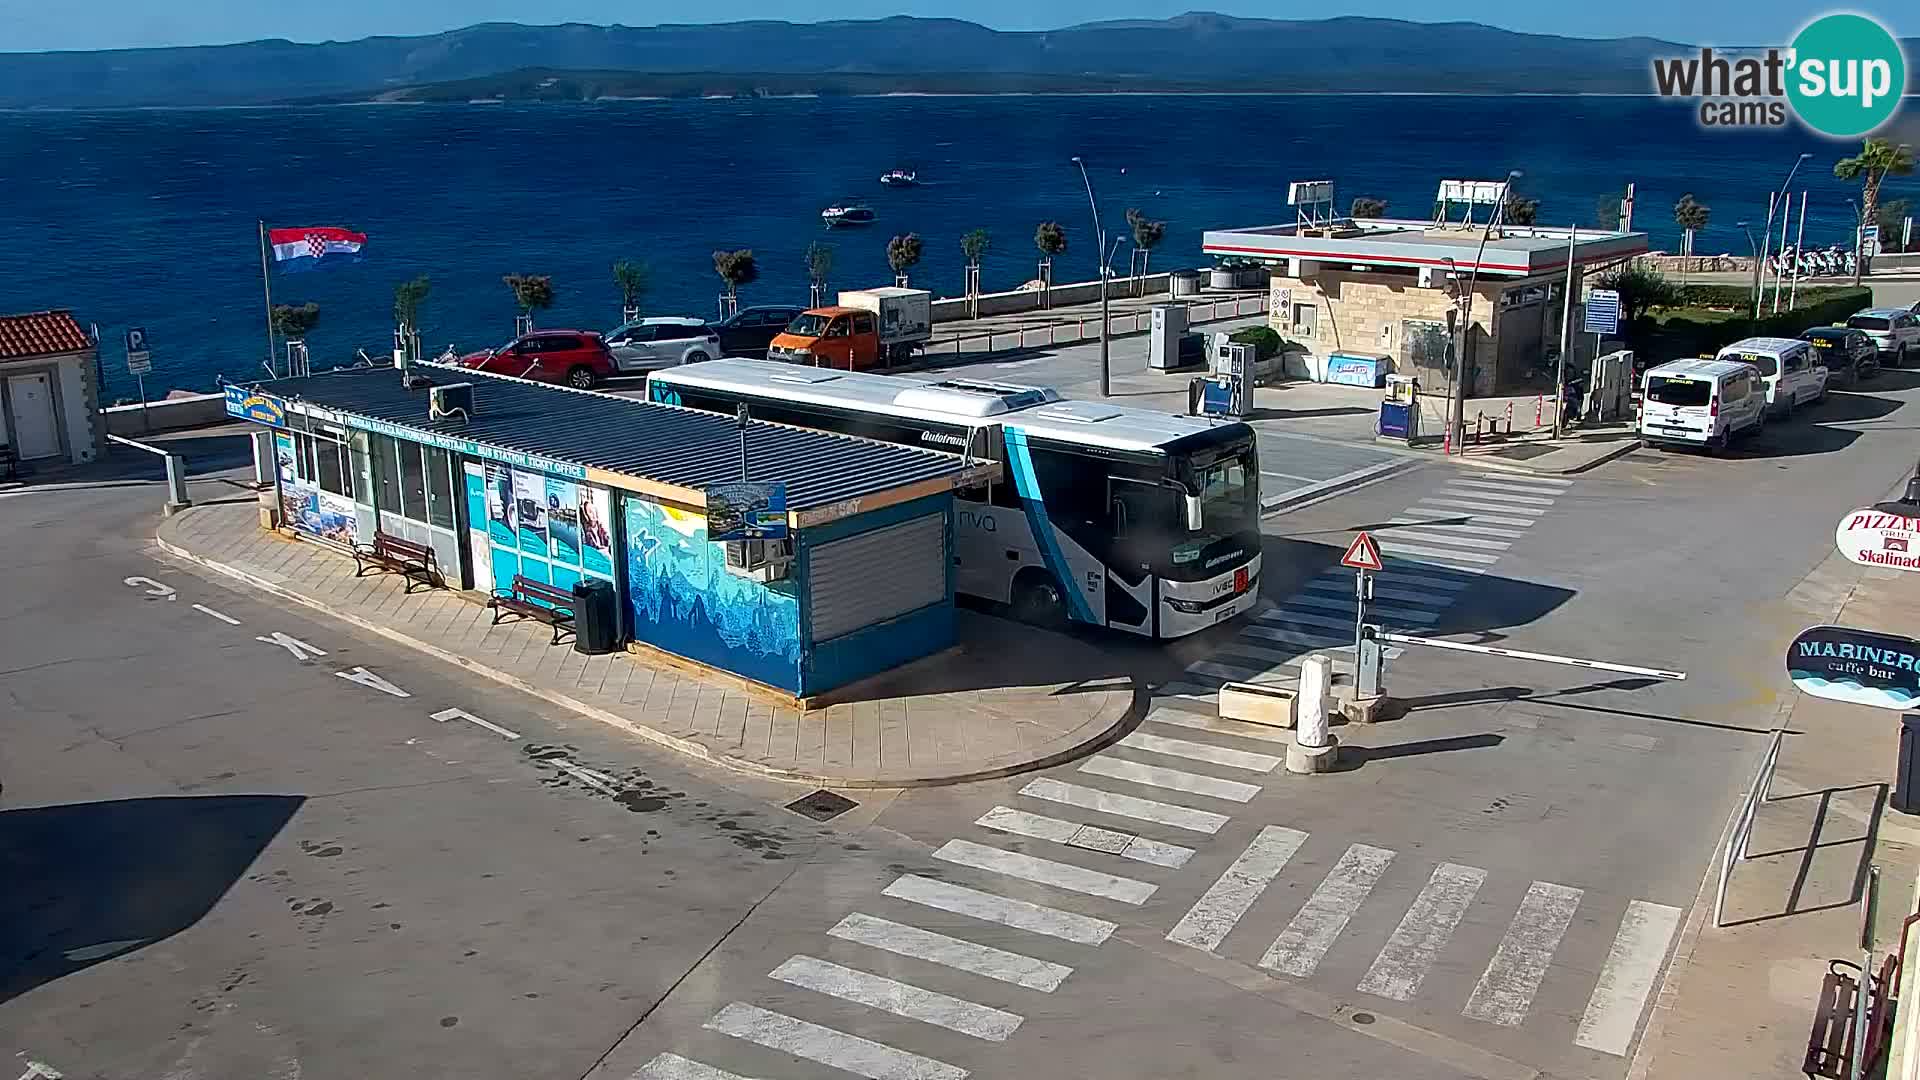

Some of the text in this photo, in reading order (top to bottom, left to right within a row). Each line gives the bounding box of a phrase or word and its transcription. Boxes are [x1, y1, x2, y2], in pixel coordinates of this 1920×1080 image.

[130, 331, 142, 349] P
[1740, 353, 1757, 361] TAXI
[436, 437, 467, 450] POSTAJA
[478, 445, 493, 458] BUS
[493, 449, 526, 464] STATION
[527, 456, 553, 470] TICKET
[554, 462, 583, 477] OFFICE
[1848, 515, 1920, 533] PIZZE
[1880, 530, 1916, 539] GRILL
[1212, 580, 1234, 595] IVEC
[1828, 661, 1896, 680] caffe bar
